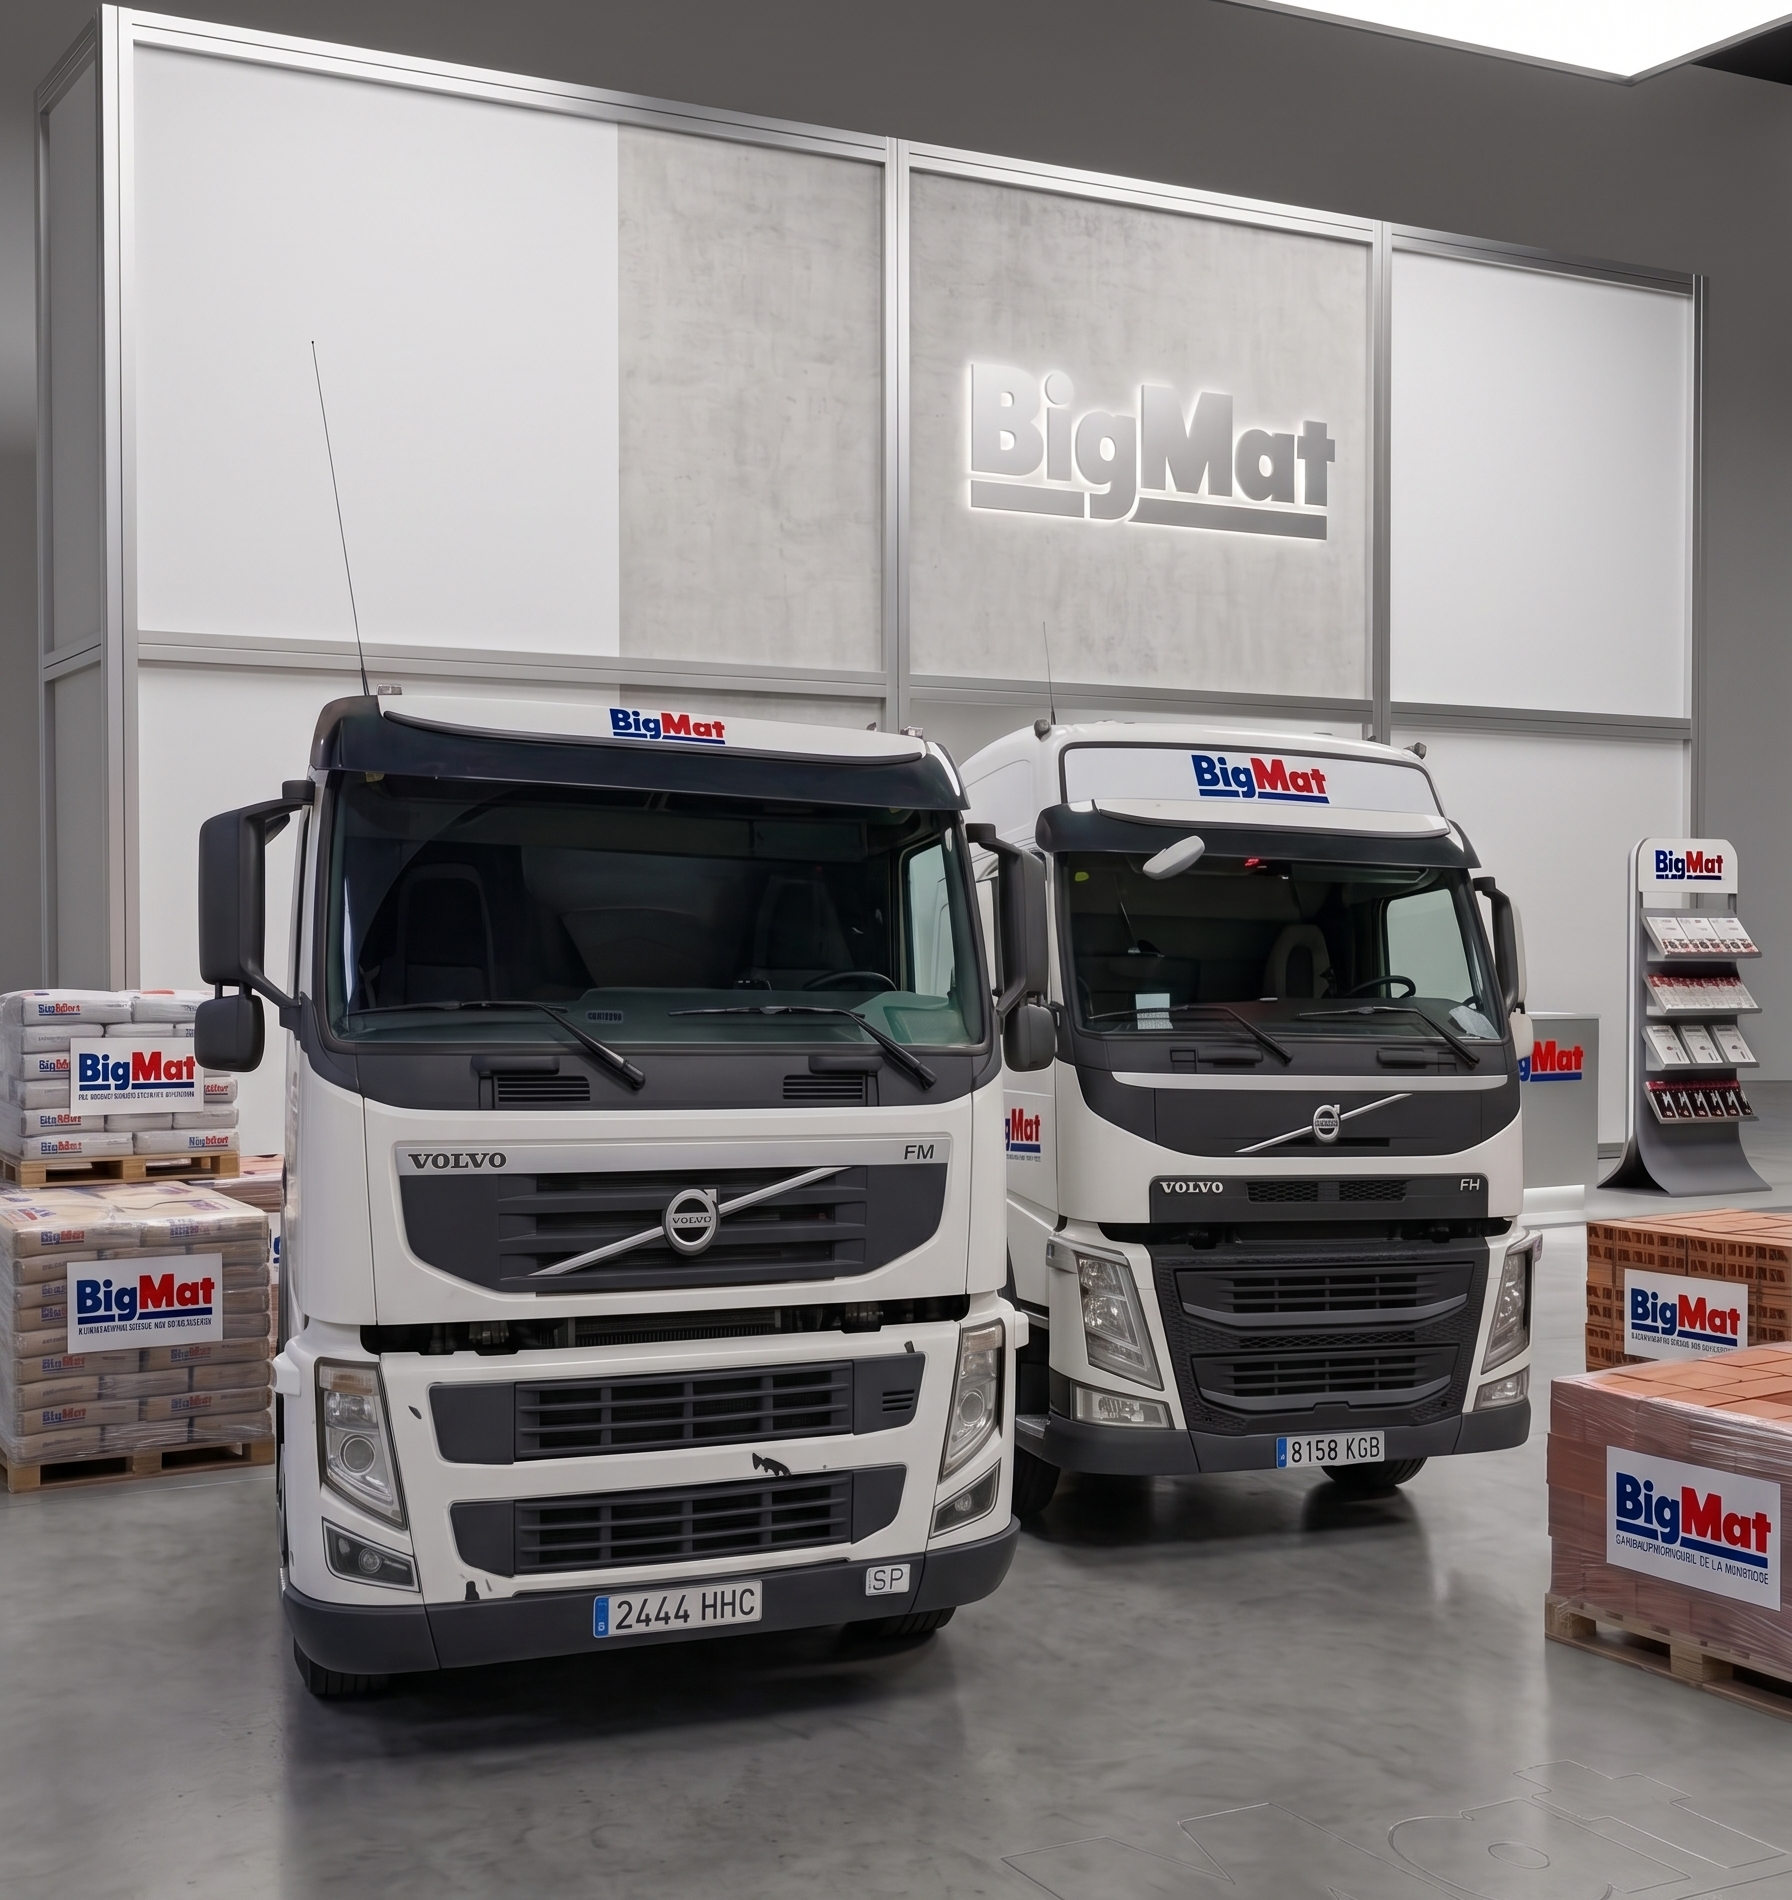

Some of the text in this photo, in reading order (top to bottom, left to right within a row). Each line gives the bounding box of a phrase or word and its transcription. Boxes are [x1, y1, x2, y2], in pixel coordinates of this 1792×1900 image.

[970, 362, 1336, 522] BigMat
[609, 708, 725, 740] BigMat
[1191, 754, 1327, 799] BigMat
[1655, 850, 1723, 879] BigMat
[79, 1051, 195, 1091] BigMat
[408, 1144, 934, 1169] VOLVO FM
[1160, 1178, 1480, 1194] VOLVO FH
[76, 1273, 215, 1321] BigMat
[1631, 1287, 1741, 1336] BigMat
[1291, 1436, 1380, 1463] 8158 KGB
[1616, 1471, 1772, 1555] BigMat
[873, 1567, 904, 1591] SP
[615, 1587, 756, 1631] 2444 HHC
